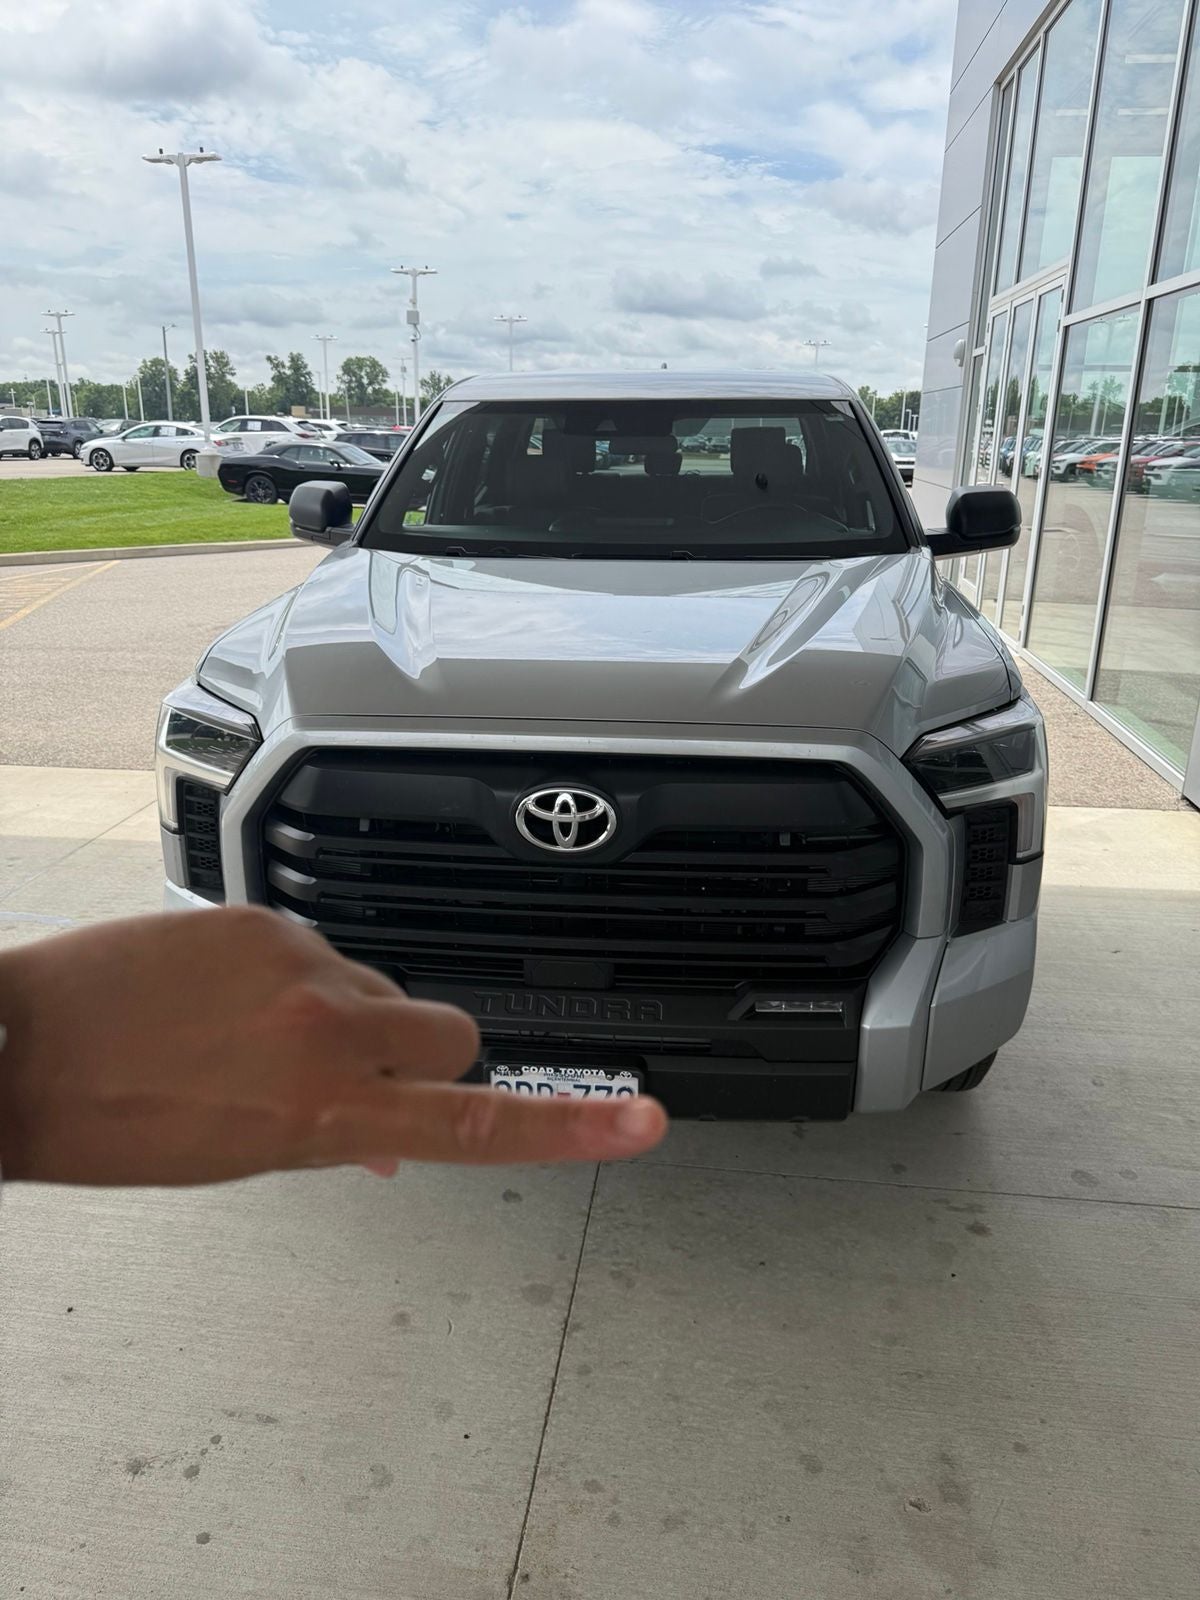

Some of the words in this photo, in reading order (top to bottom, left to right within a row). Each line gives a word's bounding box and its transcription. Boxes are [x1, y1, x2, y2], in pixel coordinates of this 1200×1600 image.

[473, 991, 664, 1021] TUNDRA
[521, 1066, 554, 1074] COAD
[559, 1067, 605, 1077] TOYOTA
